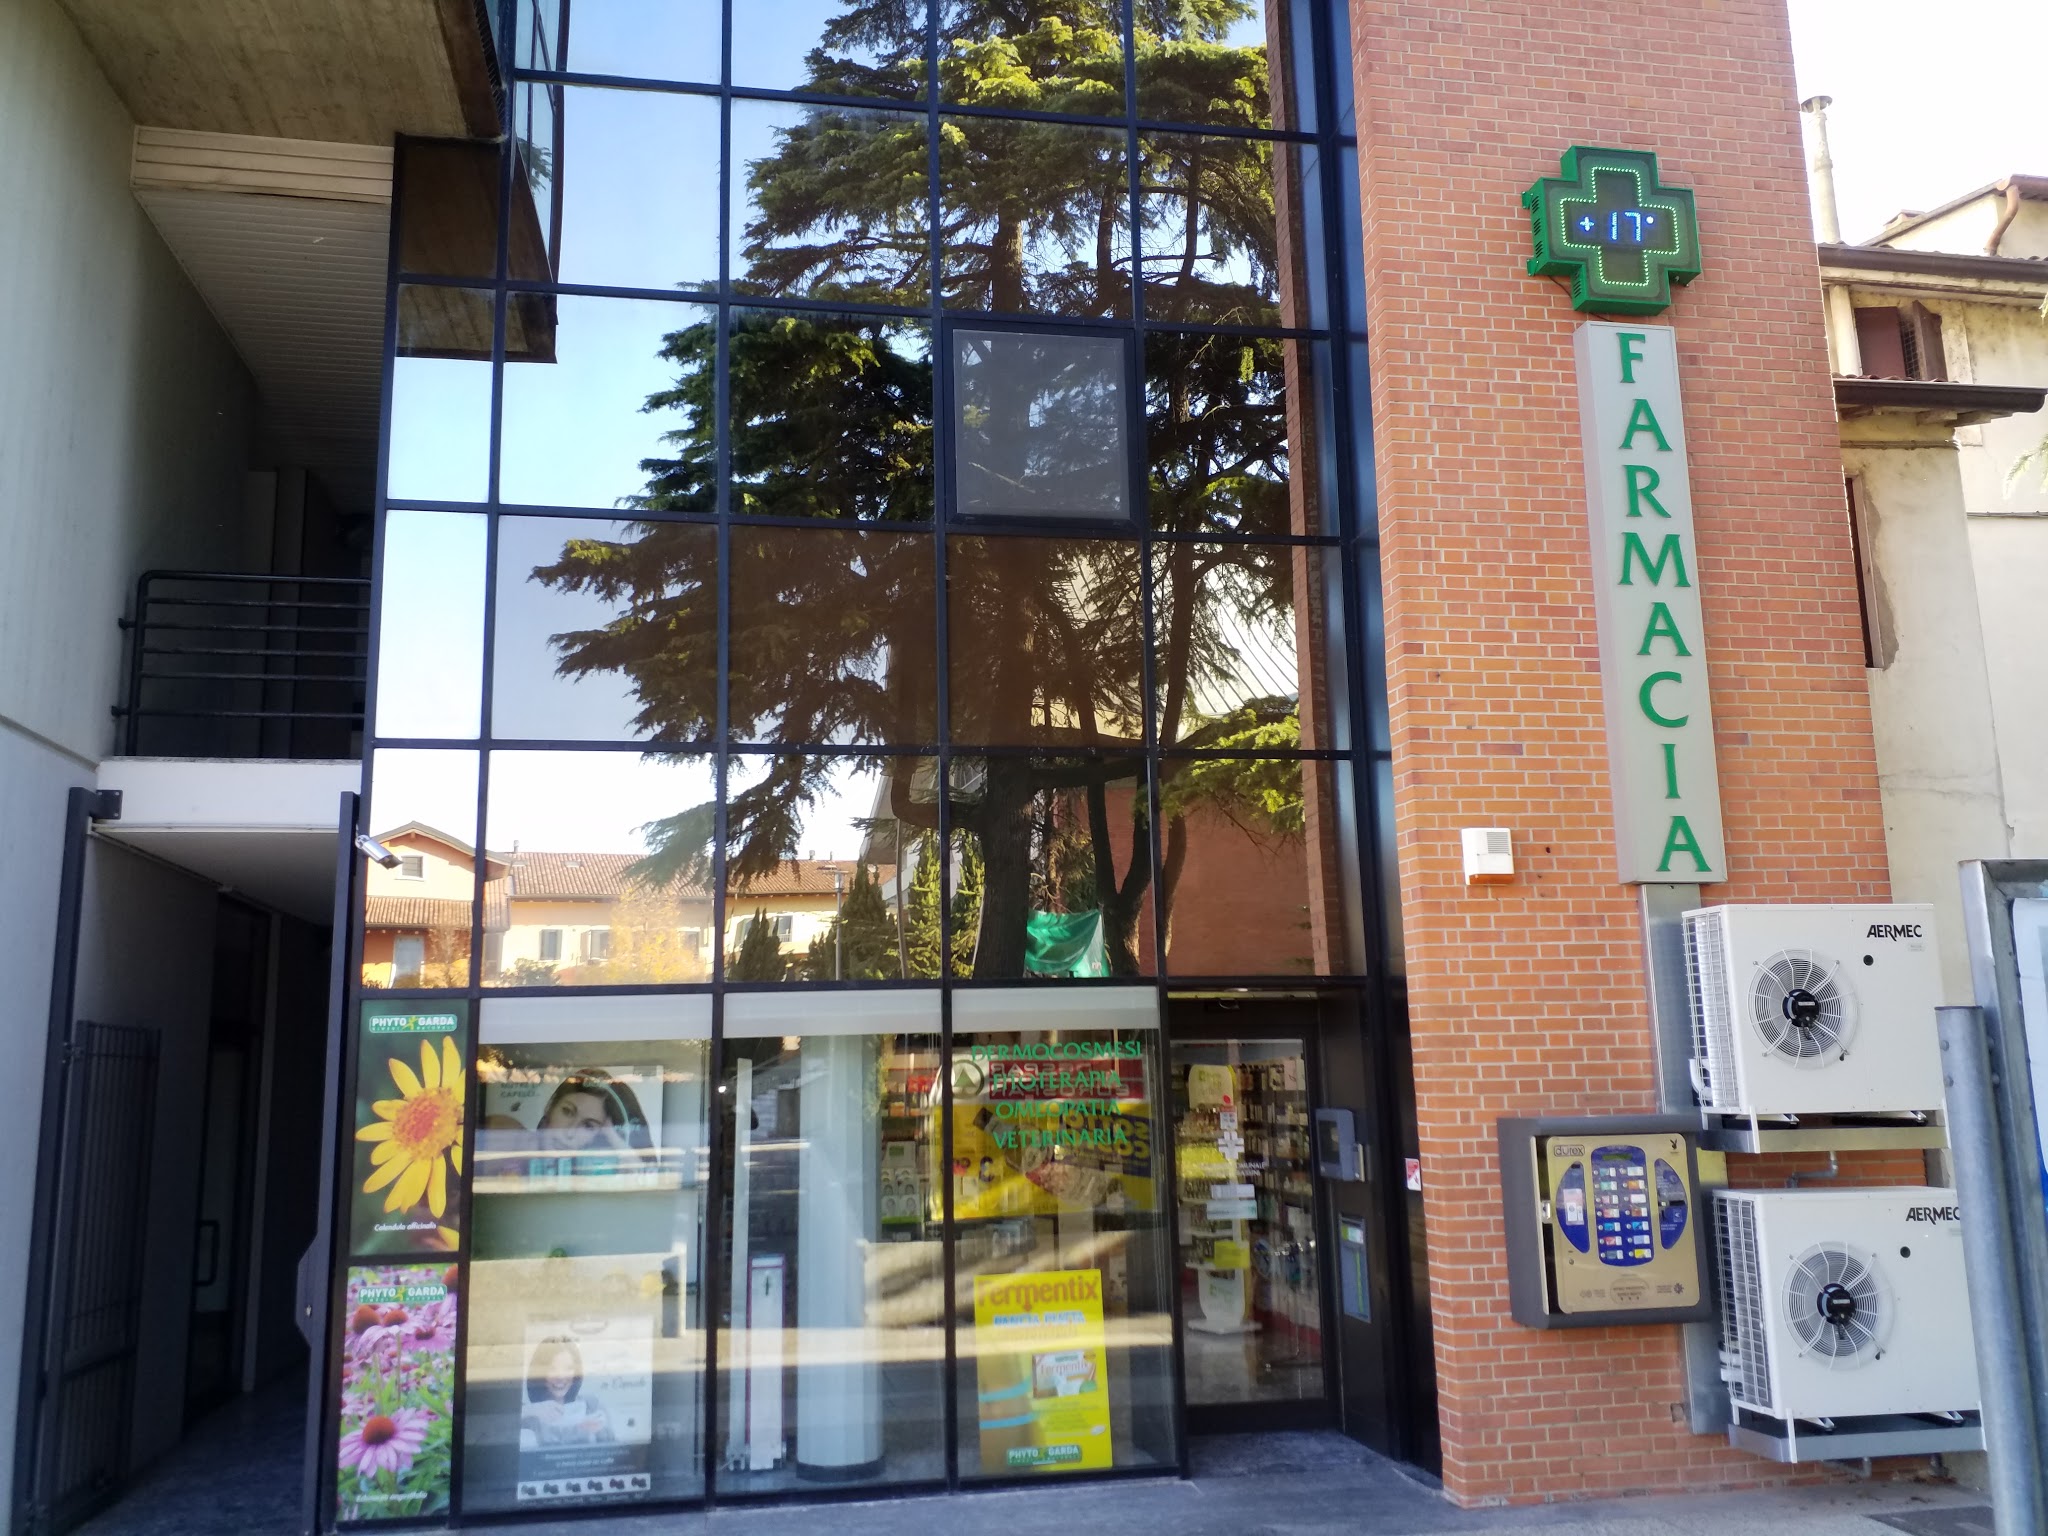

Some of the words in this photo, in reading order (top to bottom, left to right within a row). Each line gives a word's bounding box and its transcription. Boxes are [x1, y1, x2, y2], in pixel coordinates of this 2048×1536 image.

[1616, 332, 1713, 872] FARMACIA
[1866, 924, 1923, 942] AERMEC
[372, 1017, 407, 1027] PHYTO
[418, 1016, 454, 1026] GARDA
[971, 1041, 1142, 1062] DERMOCOSMESI
[992, 1070, 1122, 1092] FITOTERAPIA
[995, 1099, 1122, 1120] OMEOPATIA
[993, 1126, 1129, 1149] VETERINARIA
[1555, 1146, 1584, 1156] durex
[360, 1288, 396, 1298] PHYTO
[408, 1286, 445, 1297] GARDA
[1008, 1449, 1039, 1459] PHYTO
[1048, 1446, 1079, 1456] GARDA
